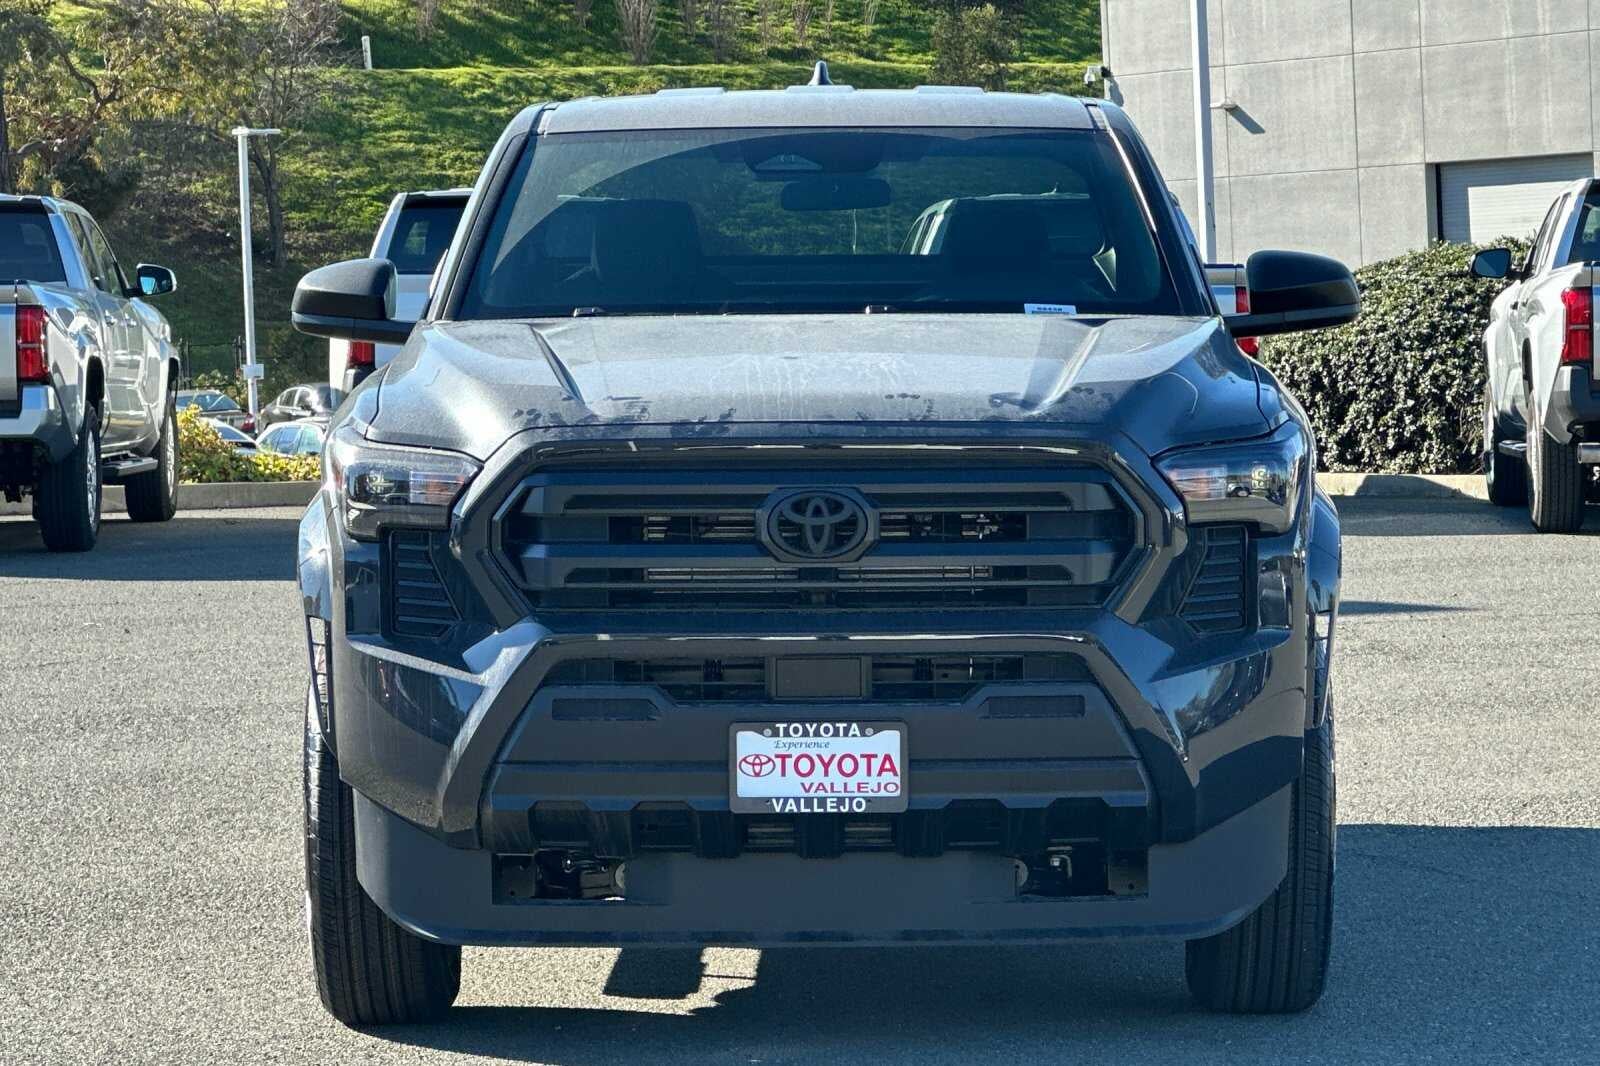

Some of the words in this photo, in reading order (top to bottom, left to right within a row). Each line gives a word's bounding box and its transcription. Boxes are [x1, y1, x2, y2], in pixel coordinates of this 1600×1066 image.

[775, 723, 861, 737] TOYOTA
[774, 740, 830, 751] Experience
[774, 753, 899, 778] TOYOTA
[800, 782, 899, 794] VALLEJO
[771, 798, 867, 813] VALLEJO
